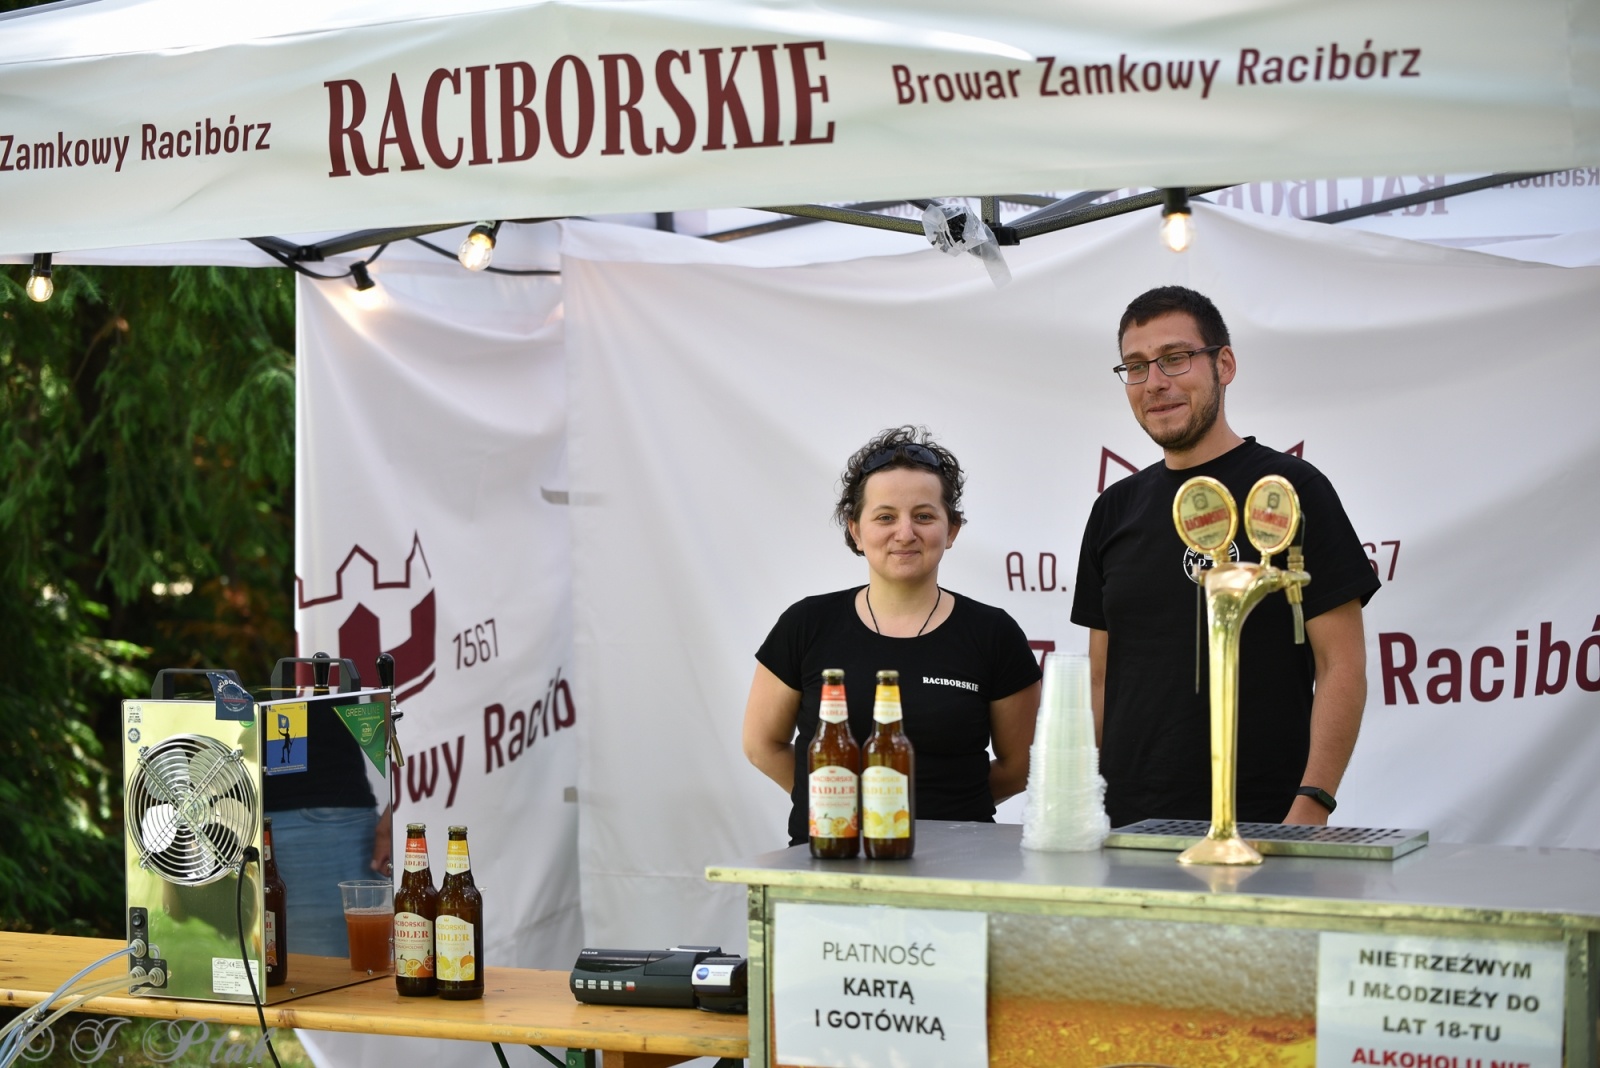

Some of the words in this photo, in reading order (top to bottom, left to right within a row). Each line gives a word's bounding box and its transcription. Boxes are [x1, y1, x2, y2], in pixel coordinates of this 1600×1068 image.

[891, 63, 1021, 106] Browar
[1036, 53, 1221, 99] Zamkowy
[1237, 39, 1422, 86] Racibórz
[324, 40, 836, 178] RACIBORSKIE
[0, 131, 131, 173] Zamkowy
[141, 114, 272, 161] Racibórz
[1006, 551, 1067, 593] A.D.
[452, 617, 499, 670] 1567
[1378, 614, 1600, 707] Racibó
[922, 676, 979, 692] RACIBORSKIE
[483, 666, 577, 775] Racib
[811, 785, 856, 795] RADLER
[823, 941, 936, 966] PŁATNOŚĆ
[1358, 949, 1532, 979] NIETRZEŹWYM
[843, 977, 914, 1004] KARTĄ
[1348, 980, 1355, 997] I
[1363, 981, 1499, 1009] MŁODZIEŻY
[1507, 993, 1540, 1013] DO
[815, 1009, 820, 1027] I
[827, 1009, 946, 1041] GOTÓWKĄ
[1382, 1015, 1427, 1036] LAT
[1435, 1019, 1502, 1043] 18-TU
[1352, 1047, 1482, 1068] ALKOHOLU
